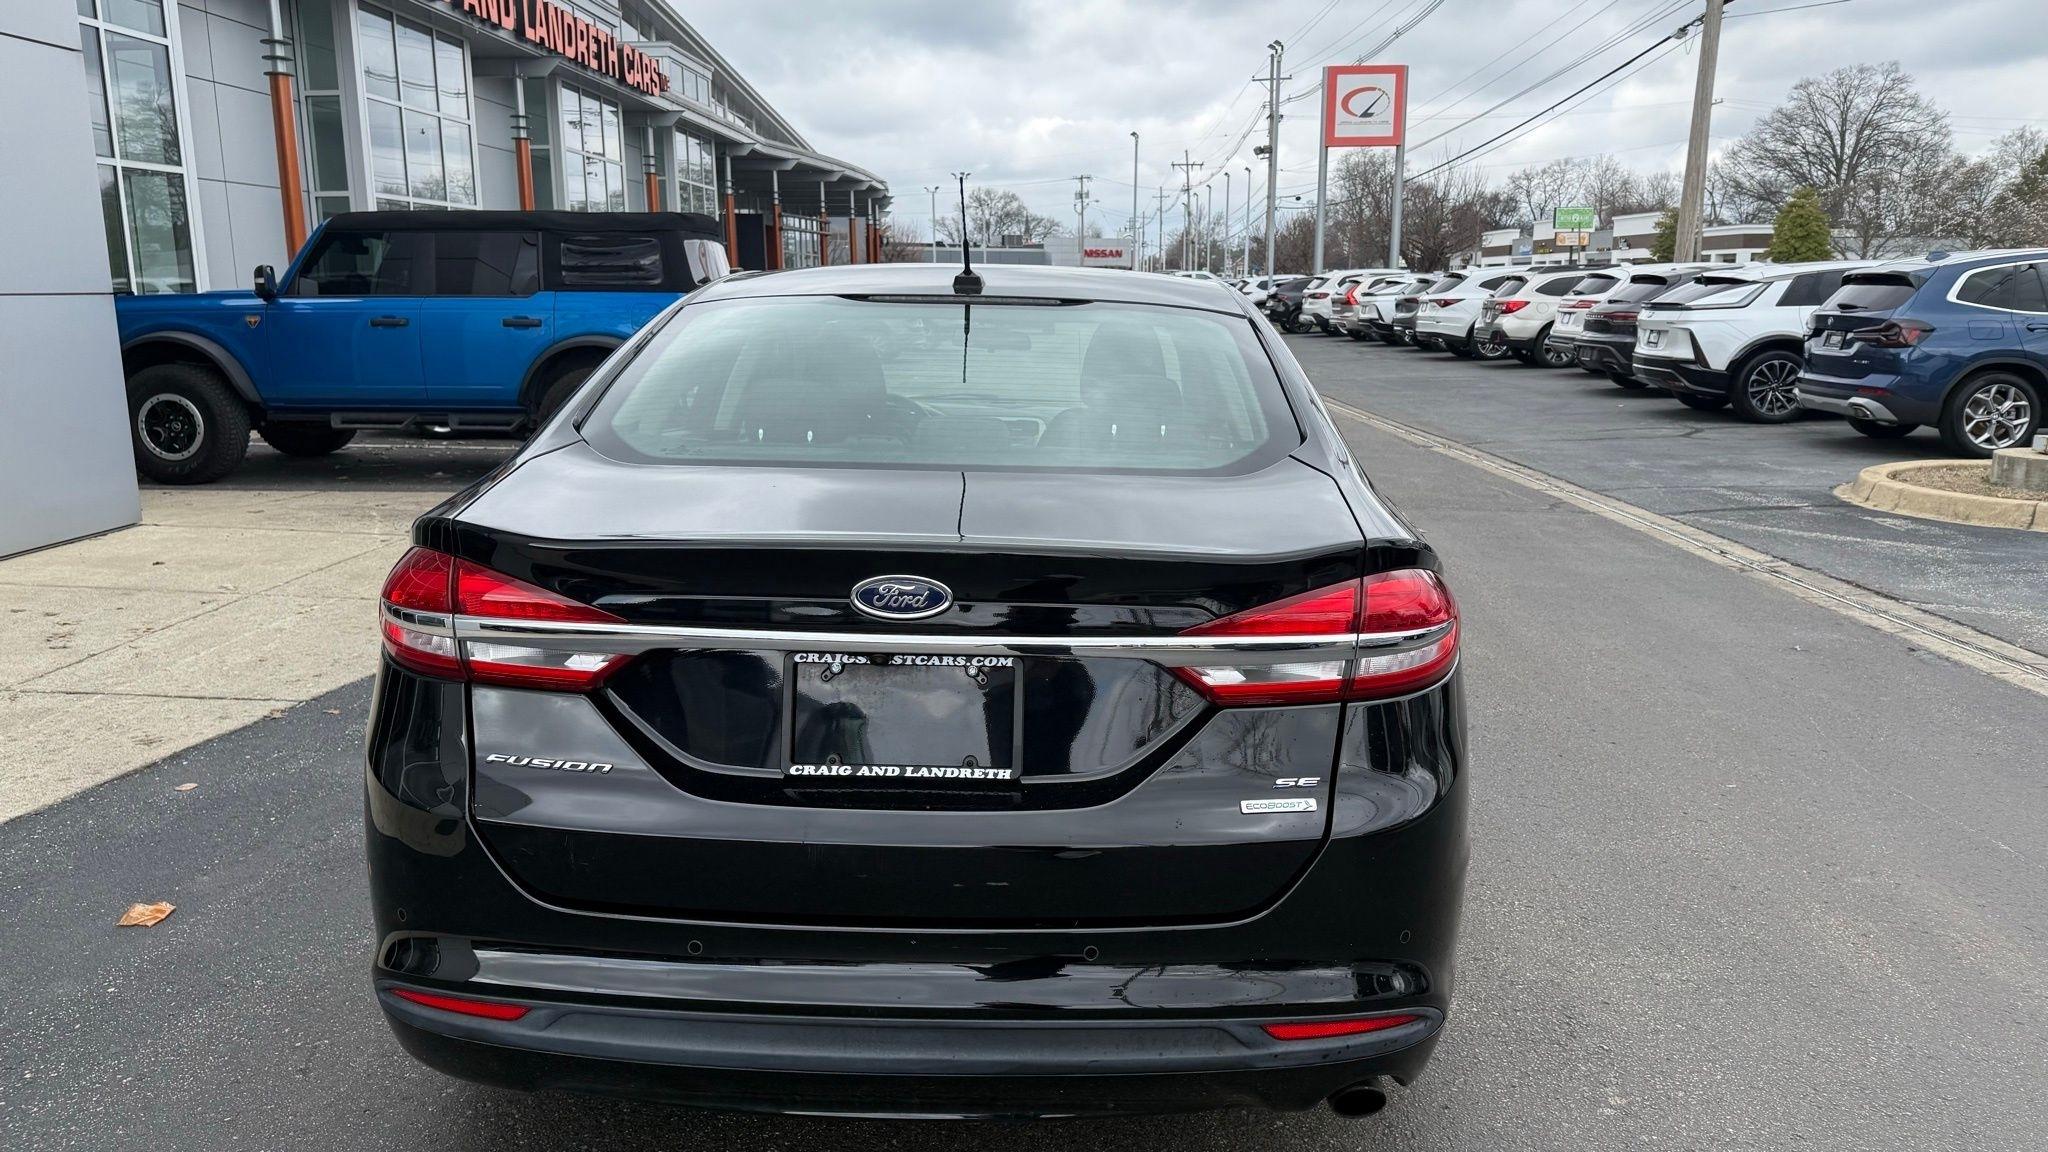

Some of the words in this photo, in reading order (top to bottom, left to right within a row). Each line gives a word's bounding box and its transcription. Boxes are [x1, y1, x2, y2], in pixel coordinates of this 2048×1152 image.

[522, 0, 619, 79] LANDRETH
[623, 42, 660, 97] CARS
[1083, 249, 1123, 258] NISSAN
[873, 583, 929, 608] Ford
[793, 653, 1014, 667] CRAIGSSTCARS.COM
[486, 753, 613, 774] FUSION
[789, 765, 853, 776] CRAIG
[856, 766, 900, 777] AND
[904, 767, 1012, 780] LANDRETH
[1273, 777, 1321, 789] SE
[1245, 801, 1303, 811] ECOBOOST
